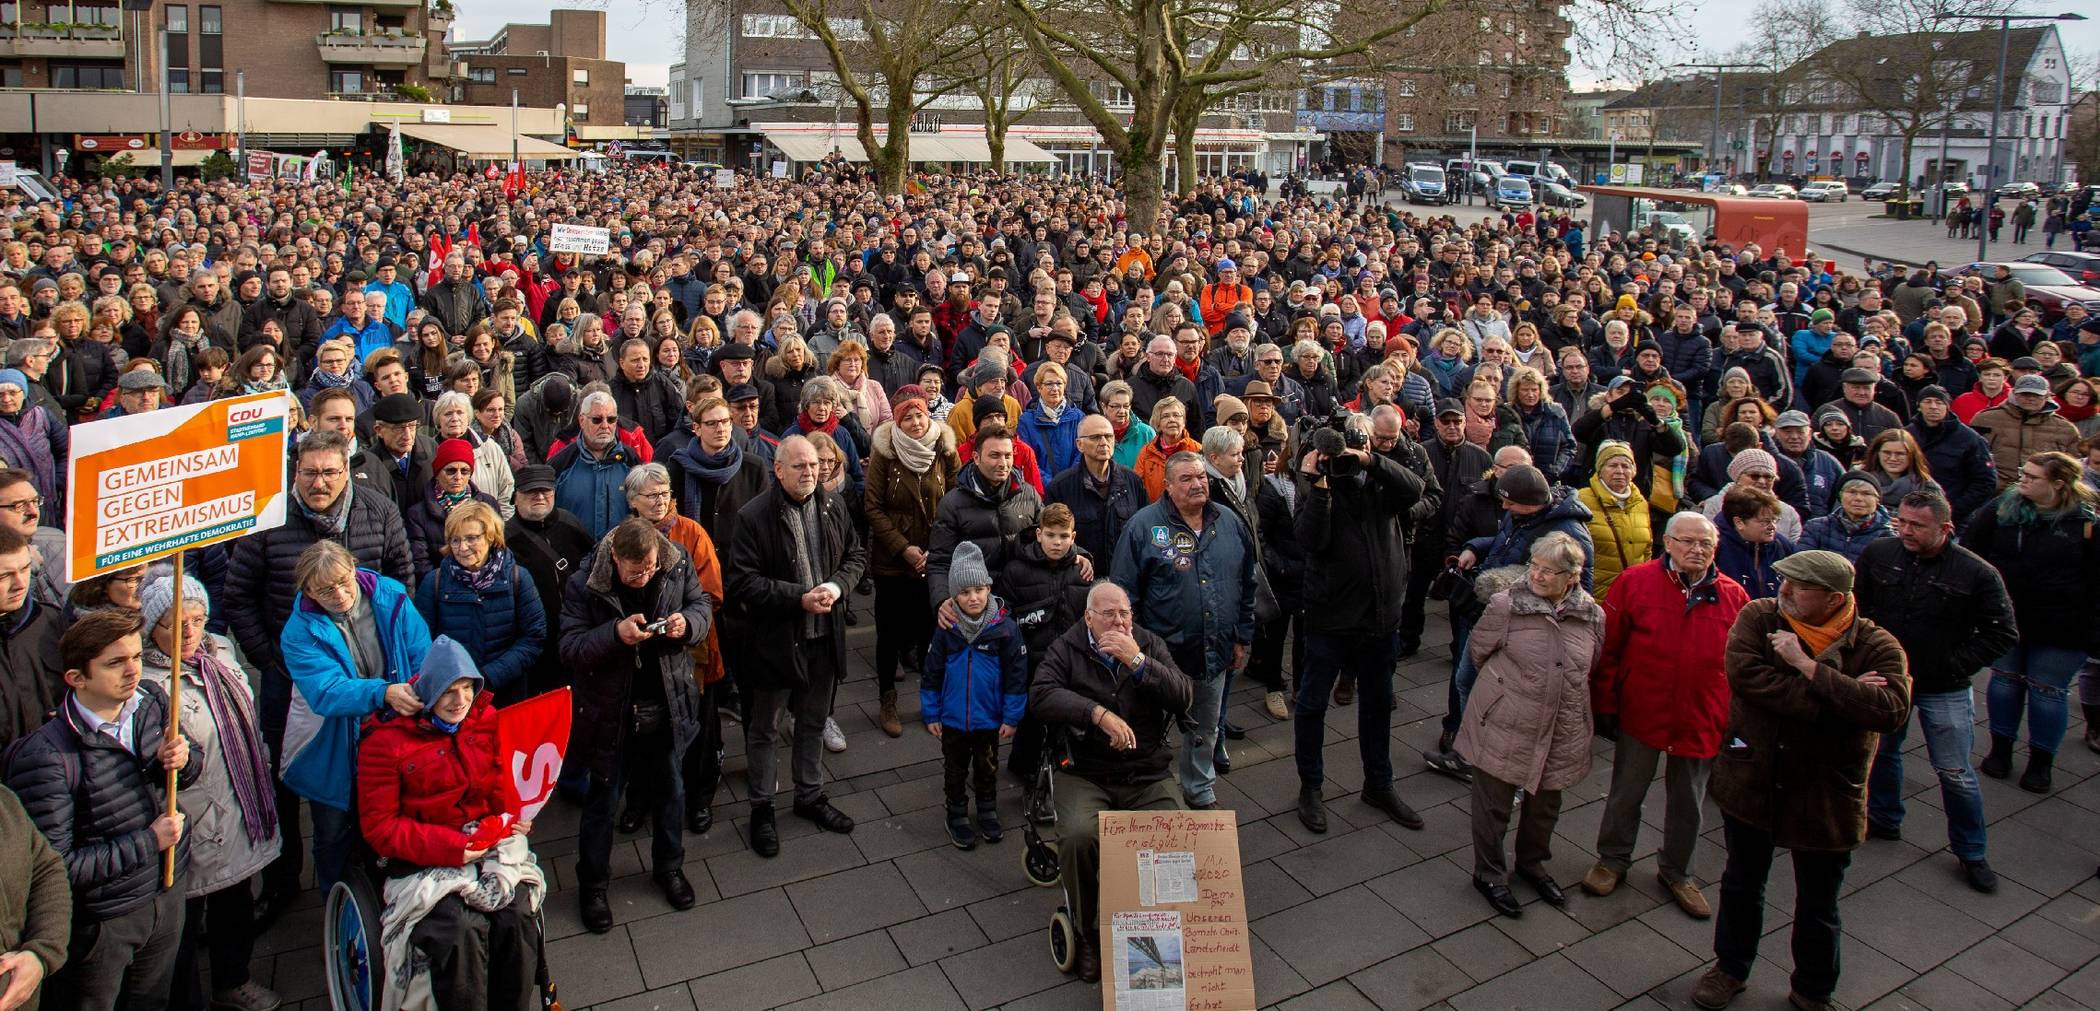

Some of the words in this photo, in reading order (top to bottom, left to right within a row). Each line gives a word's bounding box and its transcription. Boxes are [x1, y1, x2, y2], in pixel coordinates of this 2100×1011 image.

[230, 408, 263, 422] CDU
[105, 447, 236, 490] GEMEINSAM
[103, 485, 180, 519] GEGEN
[104, 494, 253, 547] EXTREMISMUS
[101, 552, 120, 566] FÜR
[122, 548, 143, 562] EINE
[145, 533, 199, 556] WEHRHAFTE
[200, 518, 254, 540] DEMOKRATIE
[1125, 839, 1138, 848] er
[1141, 834, 1155, 848] ist
[1199, 868, 1231, 881] 2020
[1186, 912, 1232, 923] Unseren
[1225, 967, 1246, 975] man
[1201, 982, 1228, 993] nicht
[1204, 1000, 1223, 1010] hat
